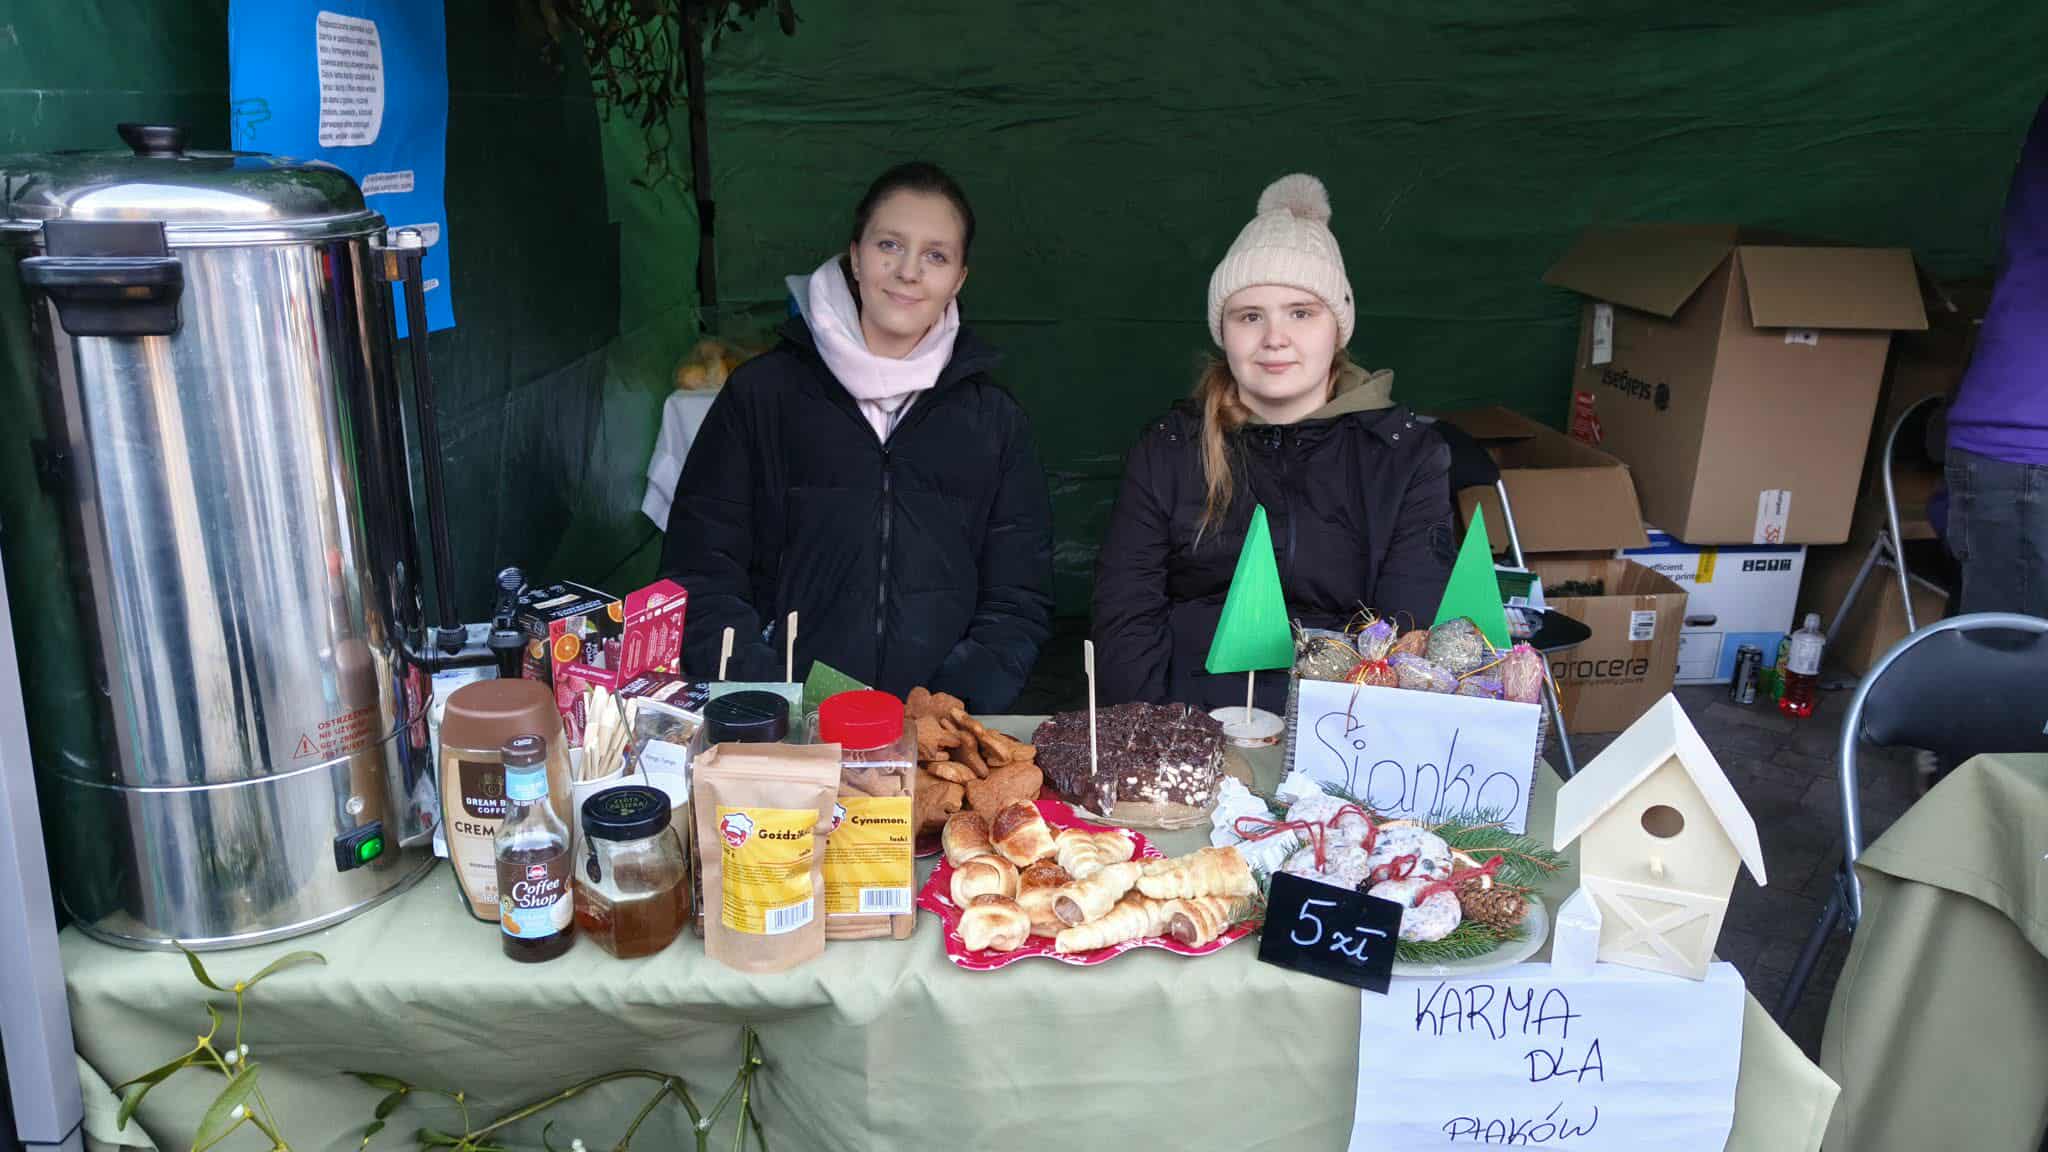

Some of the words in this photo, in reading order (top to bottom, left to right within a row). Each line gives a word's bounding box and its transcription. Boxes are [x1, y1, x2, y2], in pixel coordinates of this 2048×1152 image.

[466, 797, 497, 807] DREAM
[477, 806, 507, 815] COFFE
[512, 879, 560, 902] Coffee
[520, 893, 558, 909] Shop
[1290, 898, 1337, 946] 5
[1416, 981, 1583, 1040] KARMA
[1524, 1038, 1604, 1083] DLA
